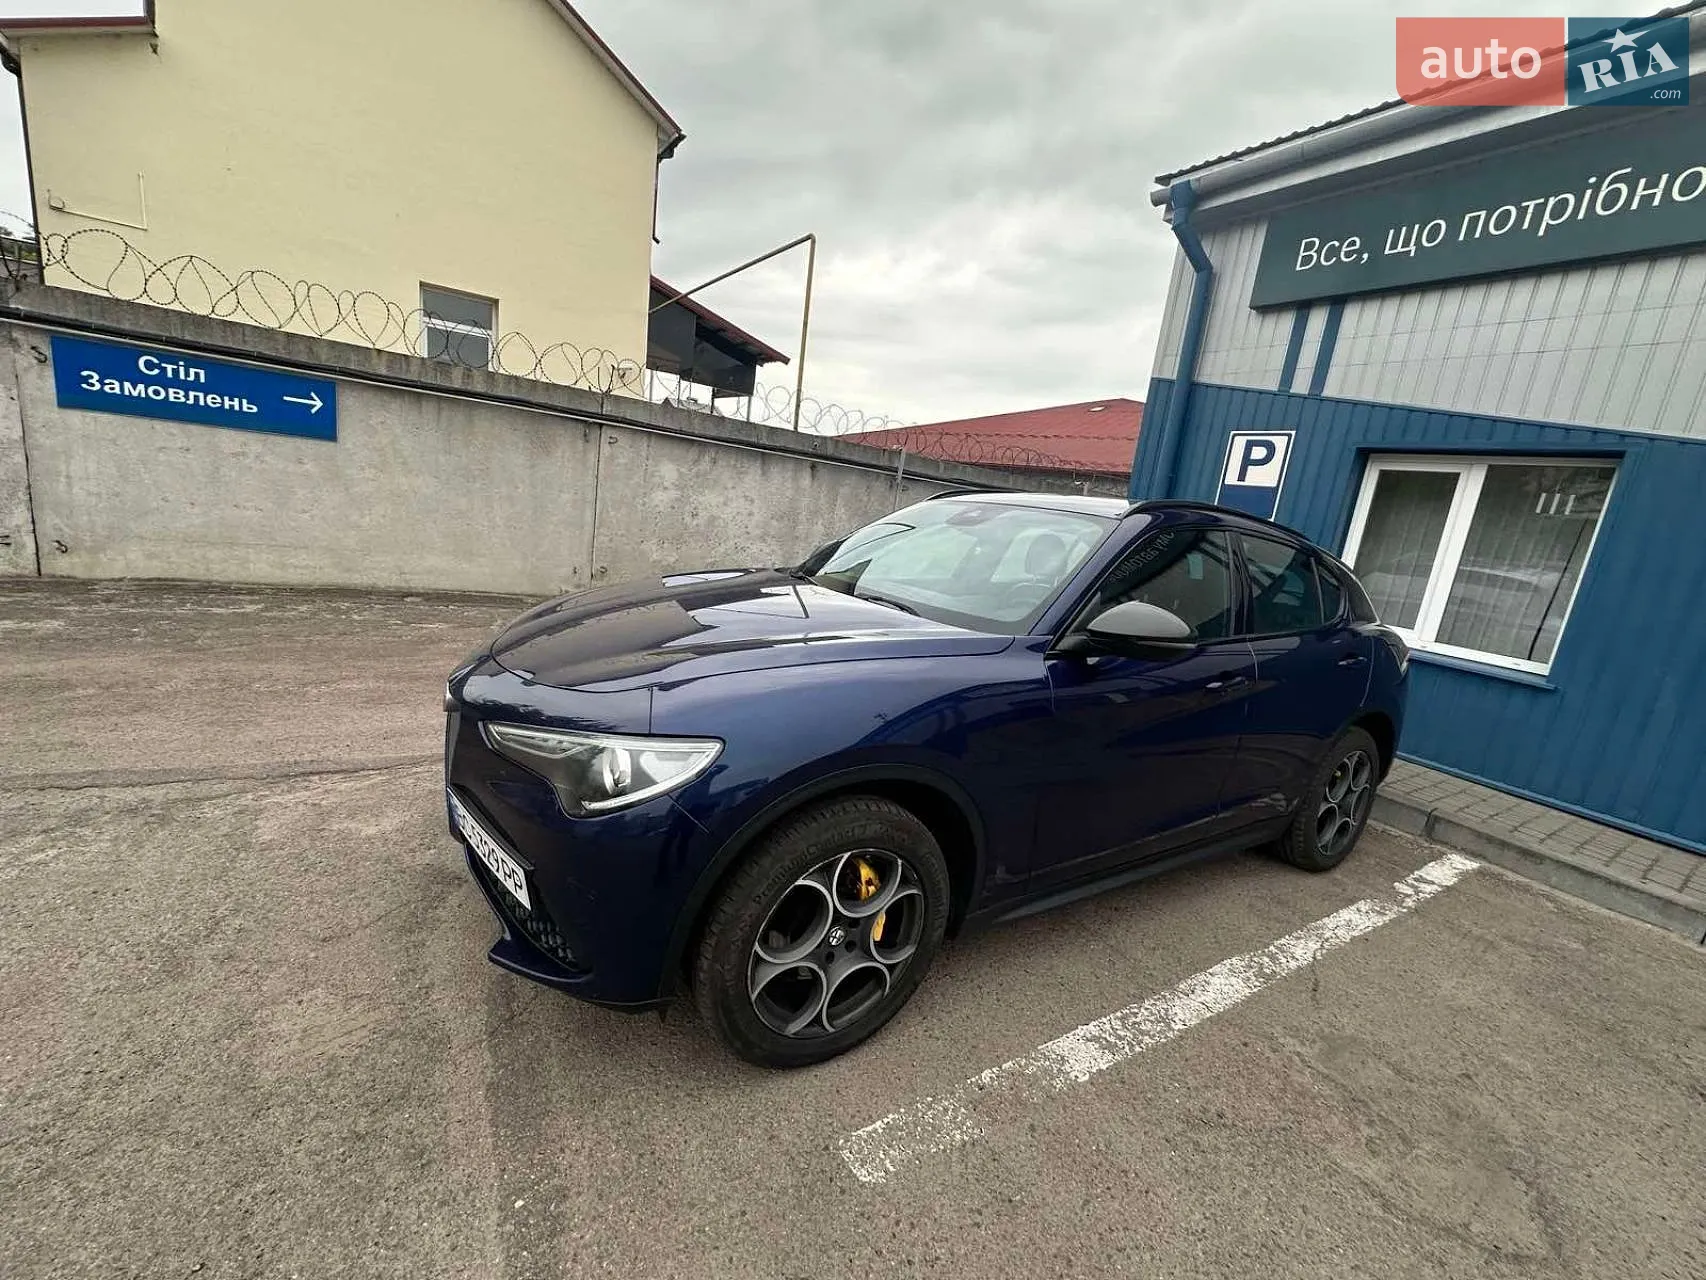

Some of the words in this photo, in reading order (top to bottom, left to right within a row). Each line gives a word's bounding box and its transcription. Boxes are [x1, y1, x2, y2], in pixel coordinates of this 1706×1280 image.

[1295, 236, 1369, 272] Все,
[1383, 219, 1447, 257] що
[1458, 165, 1706, 241] потрібно
[138, 355, 206, 384] Стіл
[80, 370, 259, 414] Замовлень
[1239, 439, 1276, 483] P
